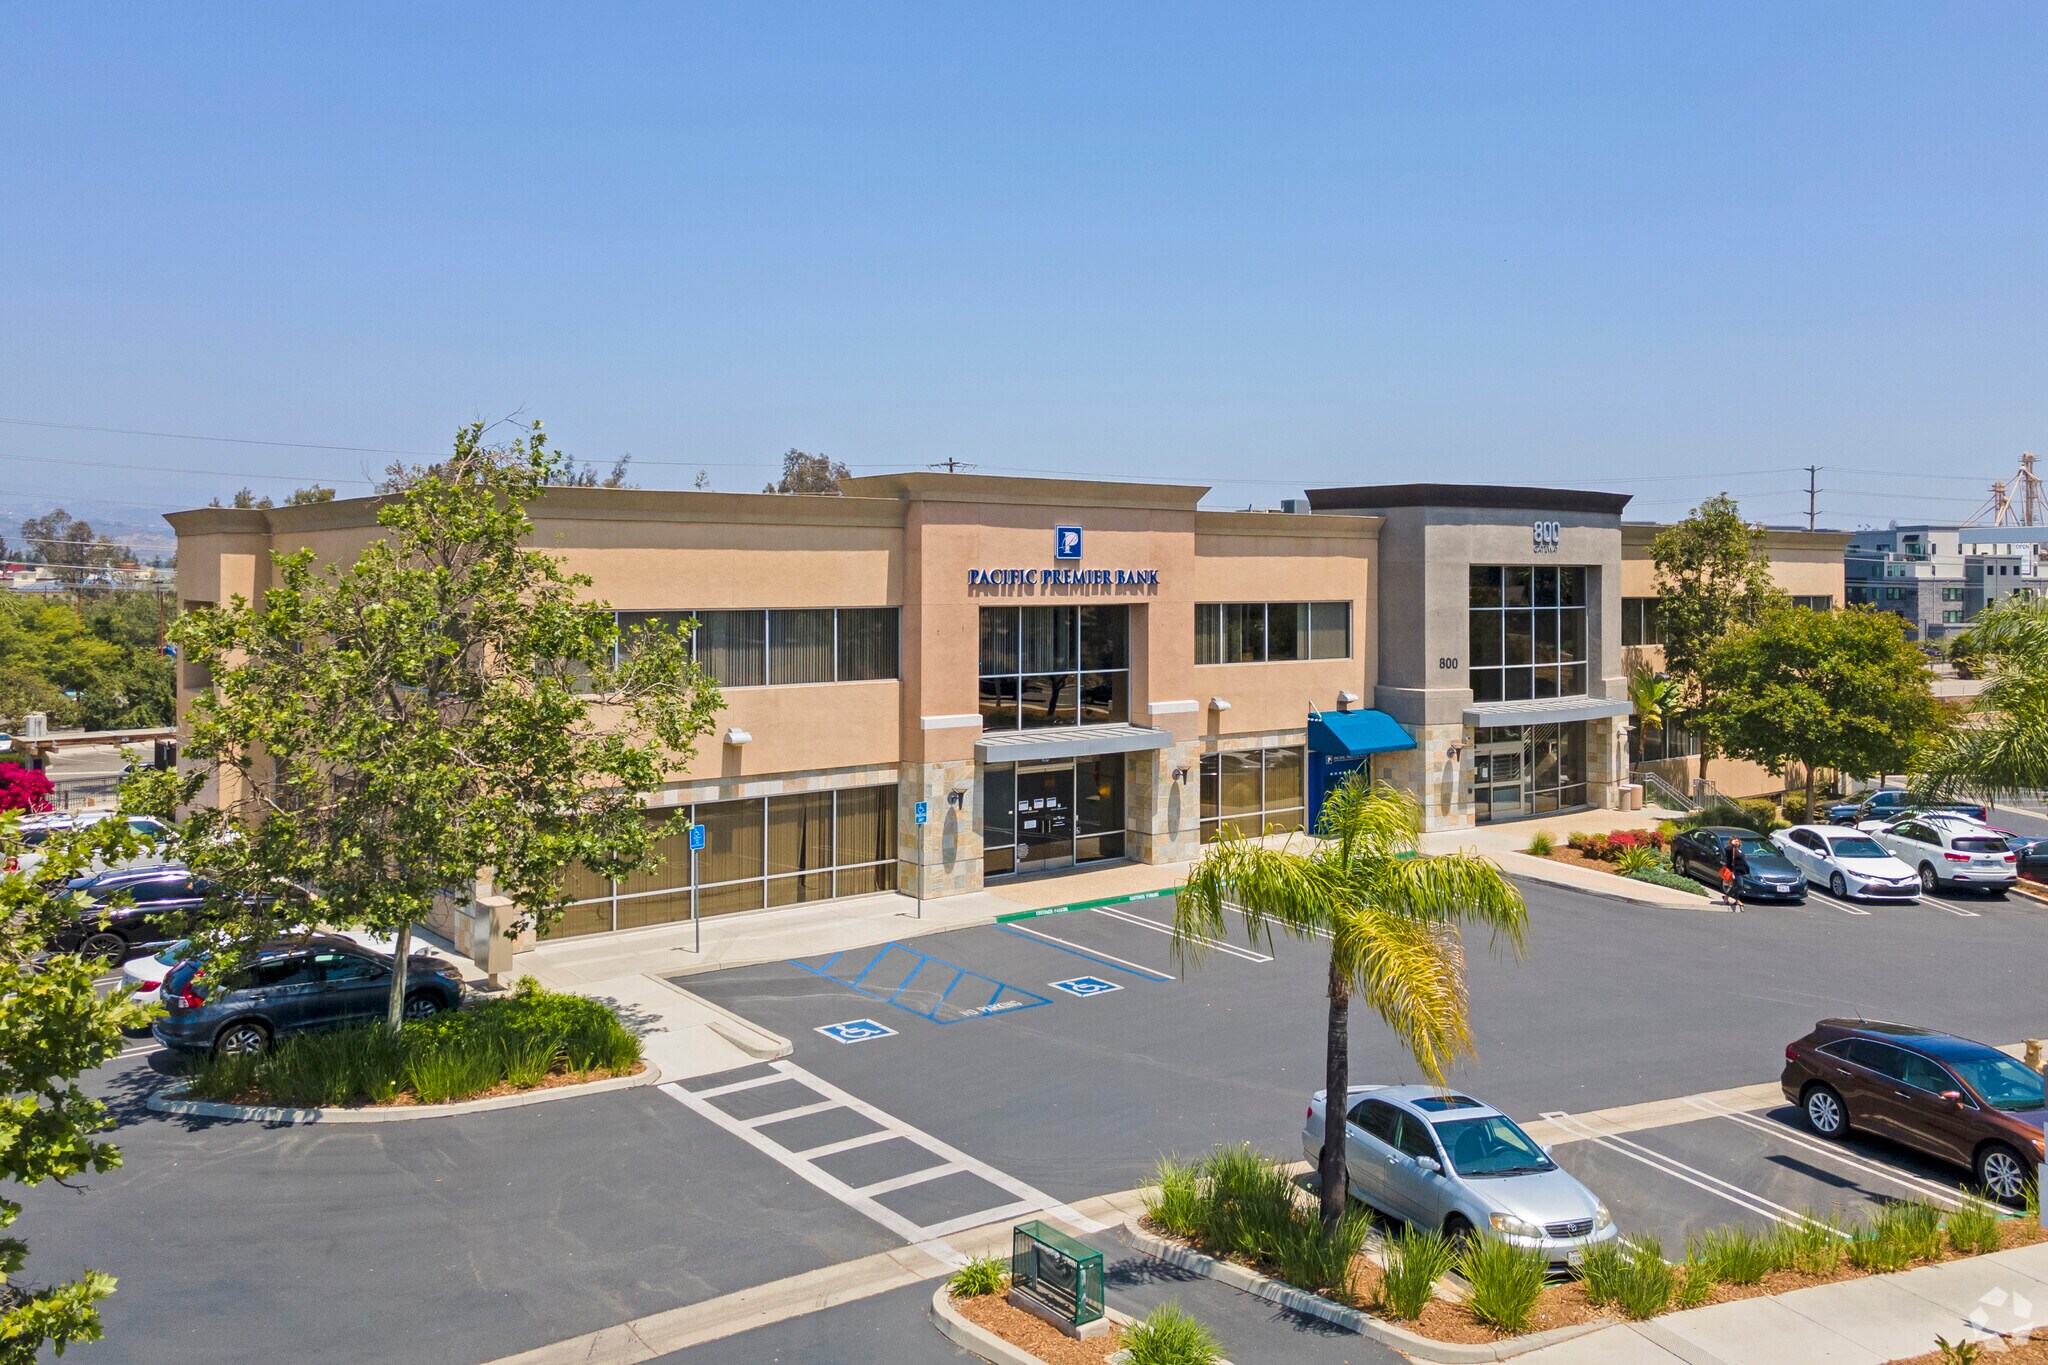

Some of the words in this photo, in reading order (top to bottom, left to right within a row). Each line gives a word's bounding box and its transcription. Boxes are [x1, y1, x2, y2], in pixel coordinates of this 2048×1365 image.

[1534, 521, 1560, 542] 800
[968, 569, 1037, 585] PACIFIC
[1041, 569, 1113, 585] PREMIER
[1116, 569, 1160, 585] BANK
[1439, 657, 1459, 669] 800
[976, 1000, 1023, 1012] PARKING
